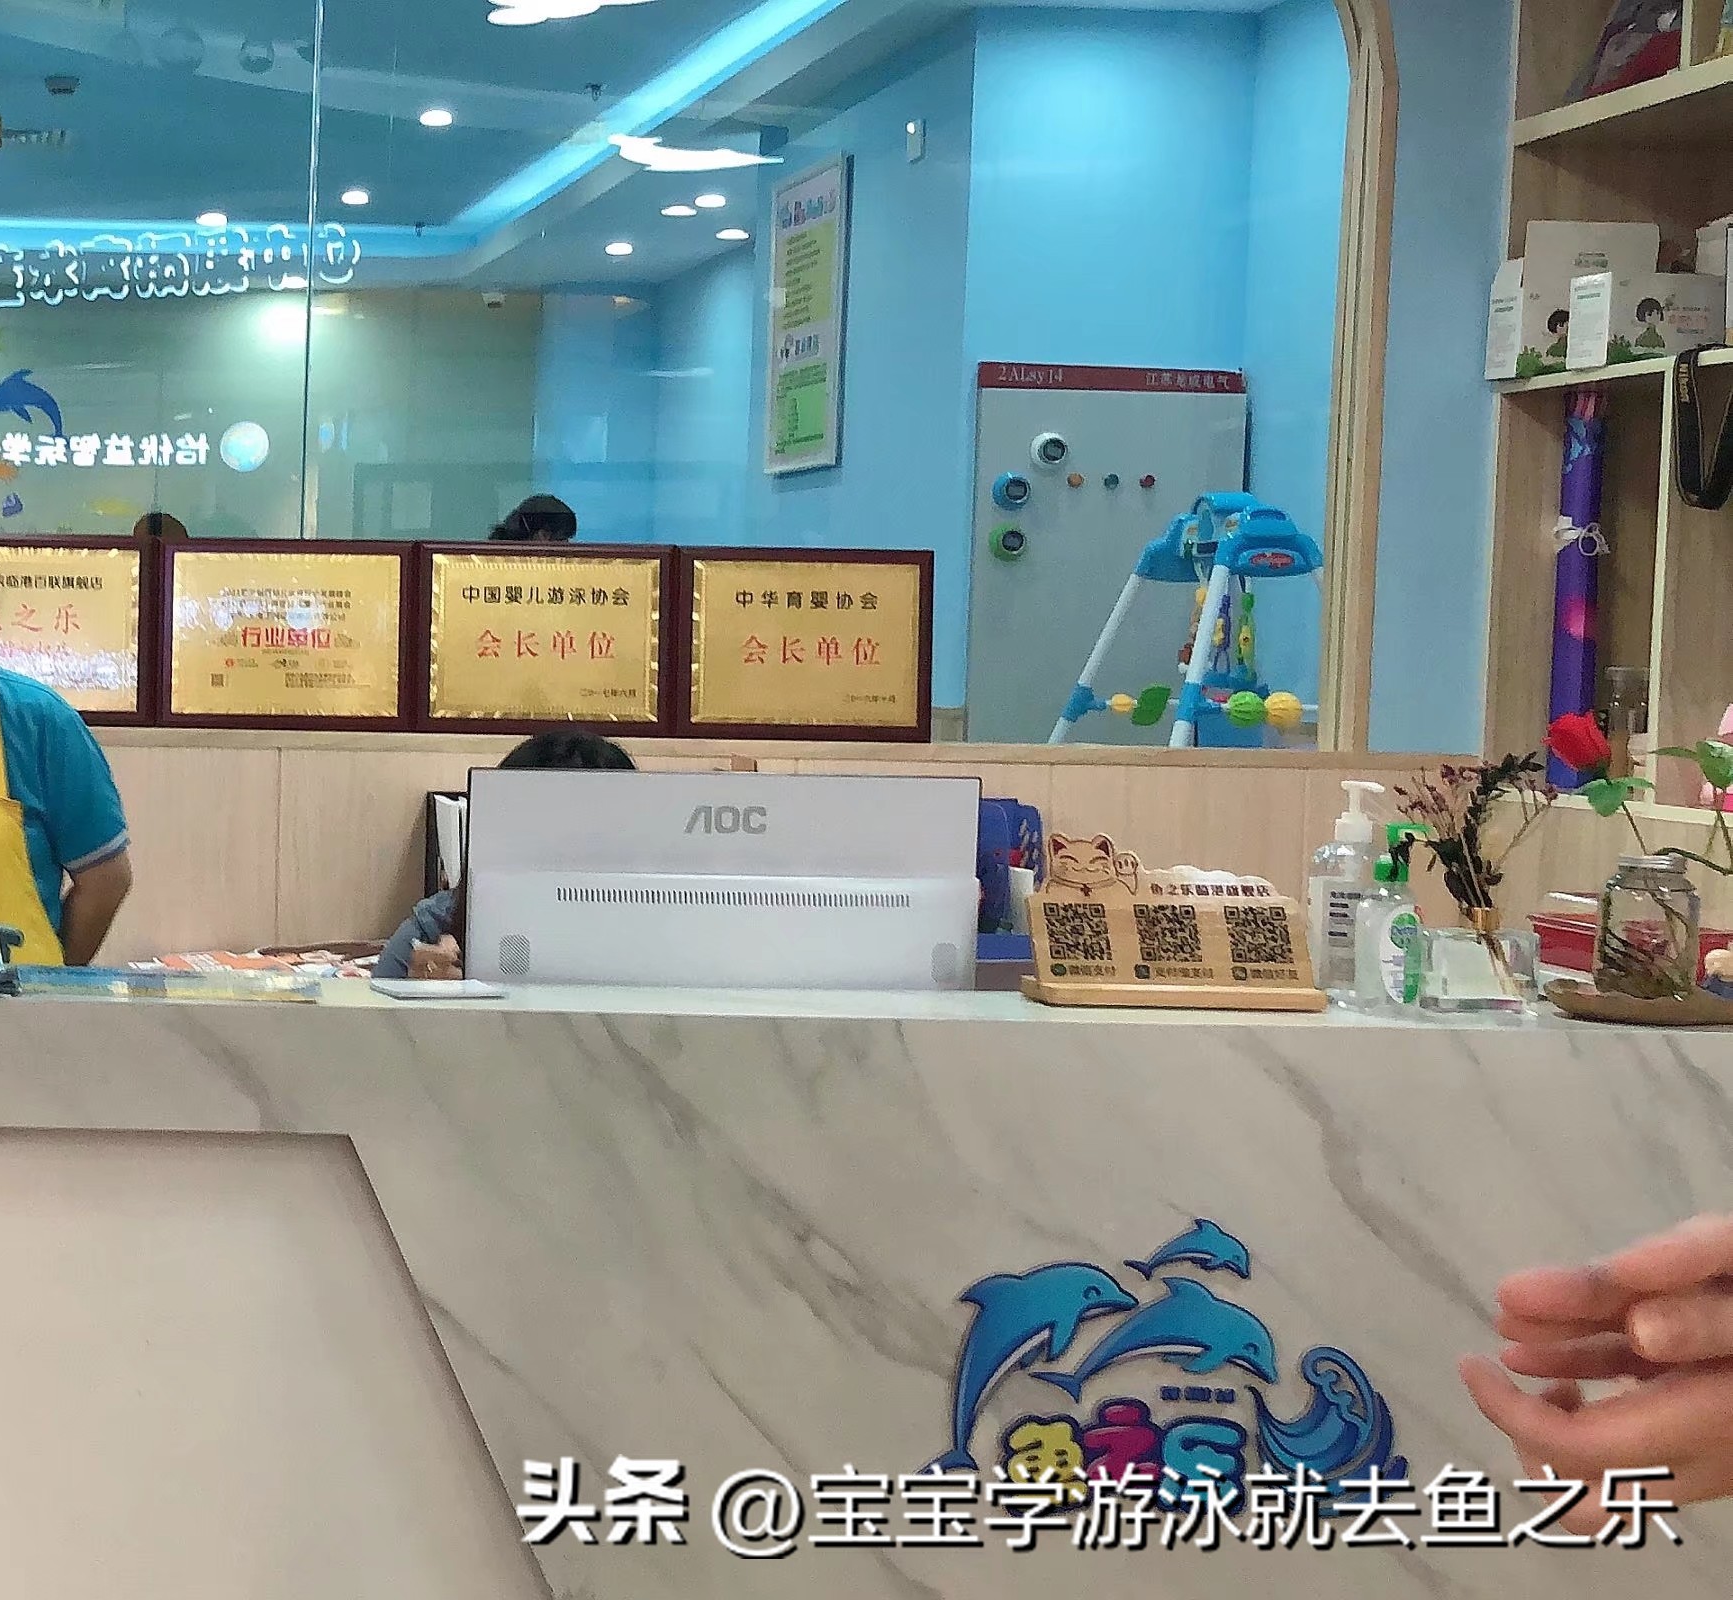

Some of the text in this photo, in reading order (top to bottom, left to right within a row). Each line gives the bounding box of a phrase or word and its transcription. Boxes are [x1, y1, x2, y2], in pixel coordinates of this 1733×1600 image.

[462, 584, 631, 607] 中国婴儿游泳协会
[734, 588, 880, 611] 中华育婴协会
[475, 628, 617, 661] 会长单位
[740, 633, 881, 667] 会长单位
[684, 805, 767, 834] AOC
